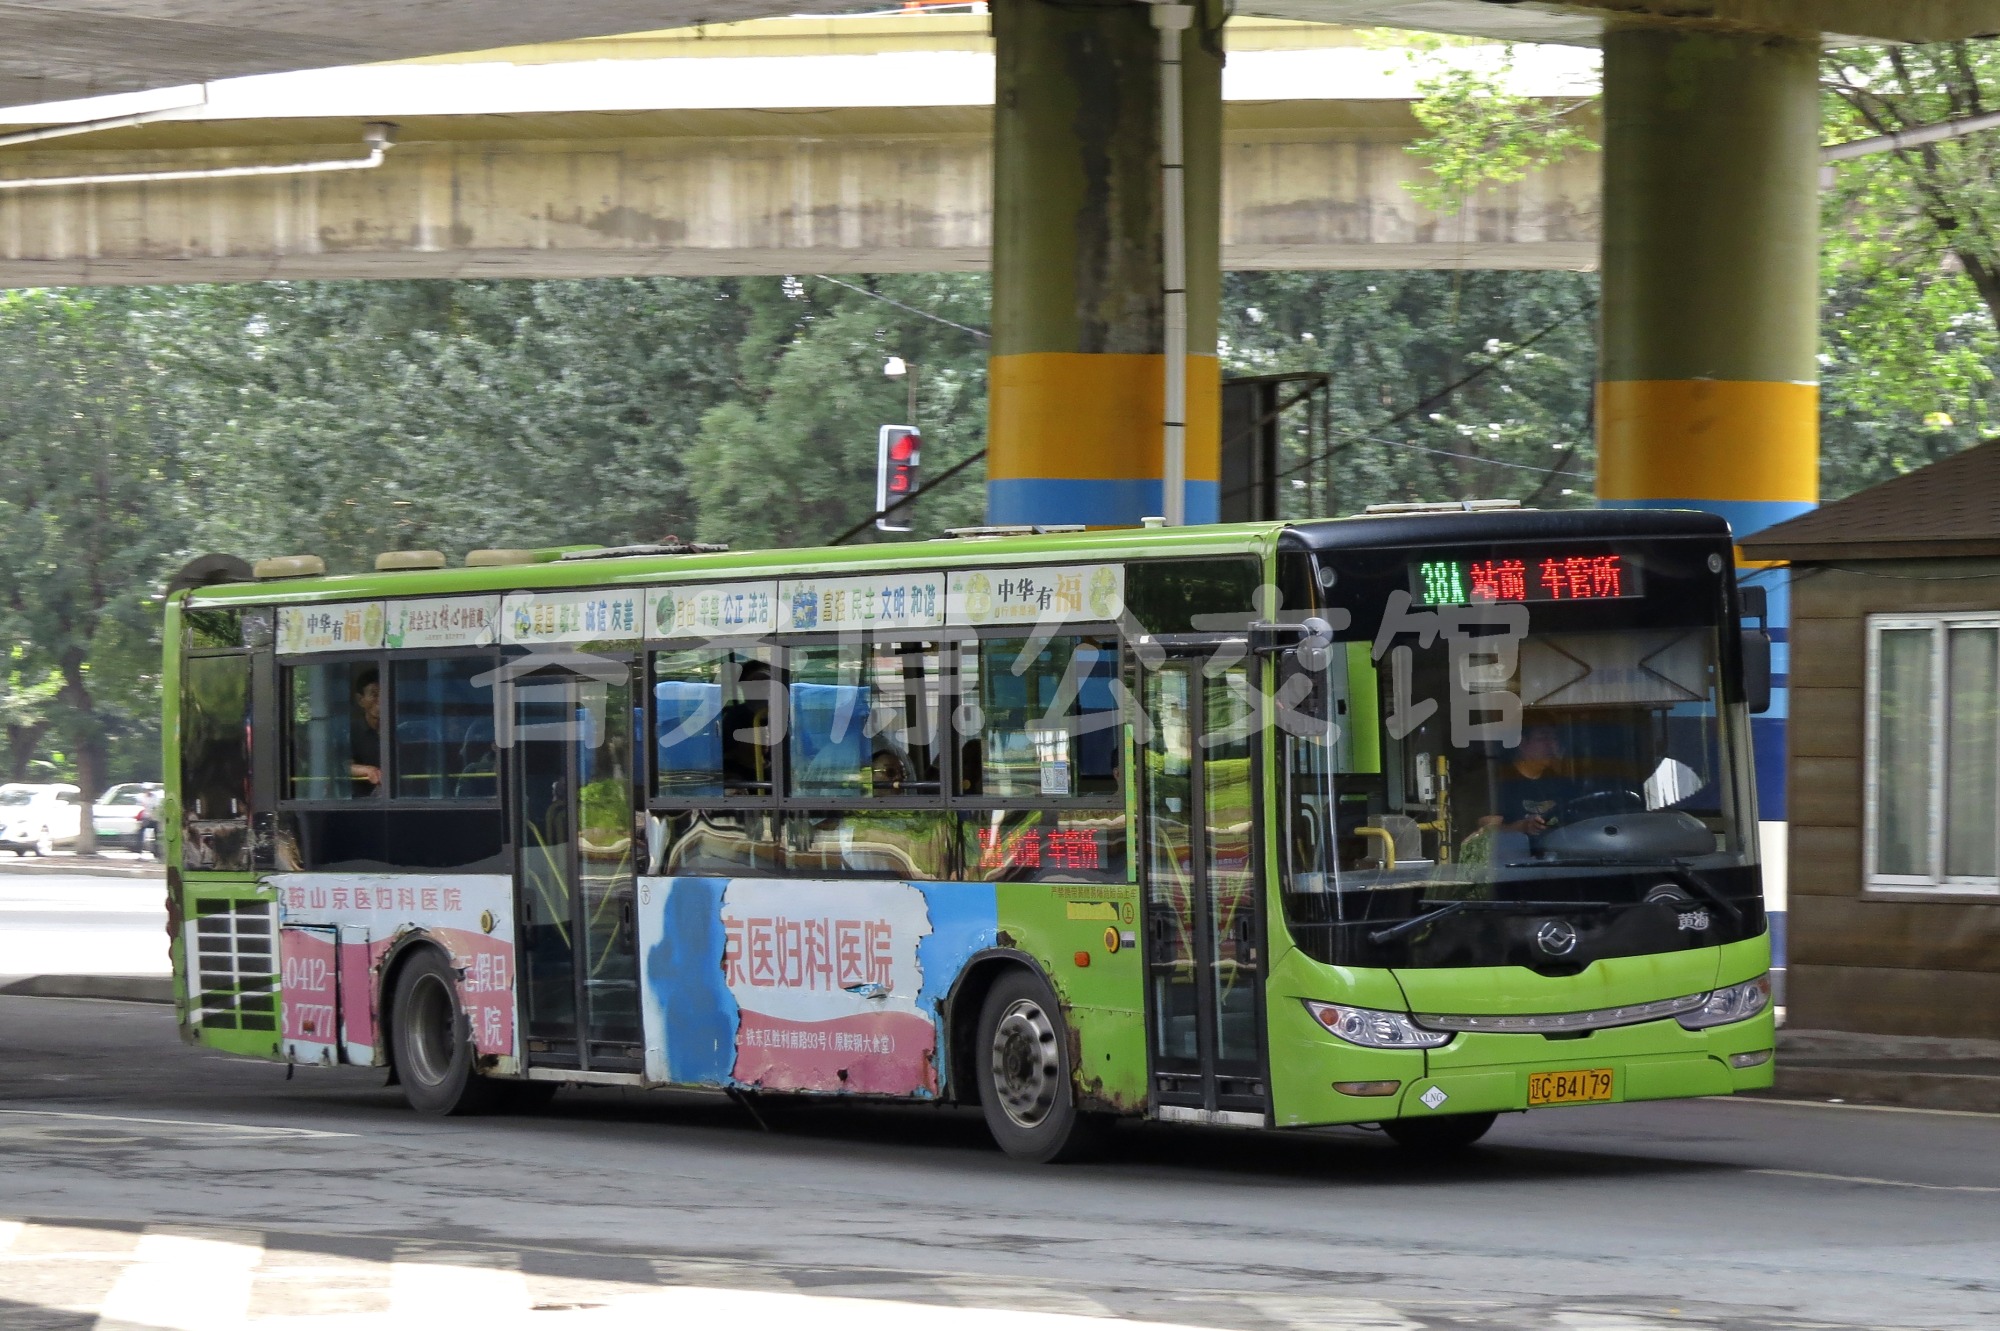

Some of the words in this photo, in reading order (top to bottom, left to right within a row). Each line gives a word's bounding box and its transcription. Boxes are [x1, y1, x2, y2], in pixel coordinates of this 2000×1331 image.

[998, 573, 1083, 613] 中华有福
[1421, 562, 1465, 604] 38A
[1470, 559, 1526, 600] 站前
[1539, 555, 1621, 599] 车管所
[611, 598, 634, 631] 友善
[676, 595, 695, 627] 自由
[724, 593, 744, 624] 公正
[748, 591, 768, 624] 法治
[823, 589, 845, 622] 富强
[851, 586, 875, 619] 民主
[881, 585, 905, 619] 文明
[911, 584, 935, 618] 和谐
[307, 609, 361, 642] 中华有福
[1048, 827, 1099, 869] 车管所
[288, 887, 462, 911] 鞍山京医妇科医院
[723, 915, 894, 990] 京医妇科医院
[1425, 1092, 1443, 1103] LNG
